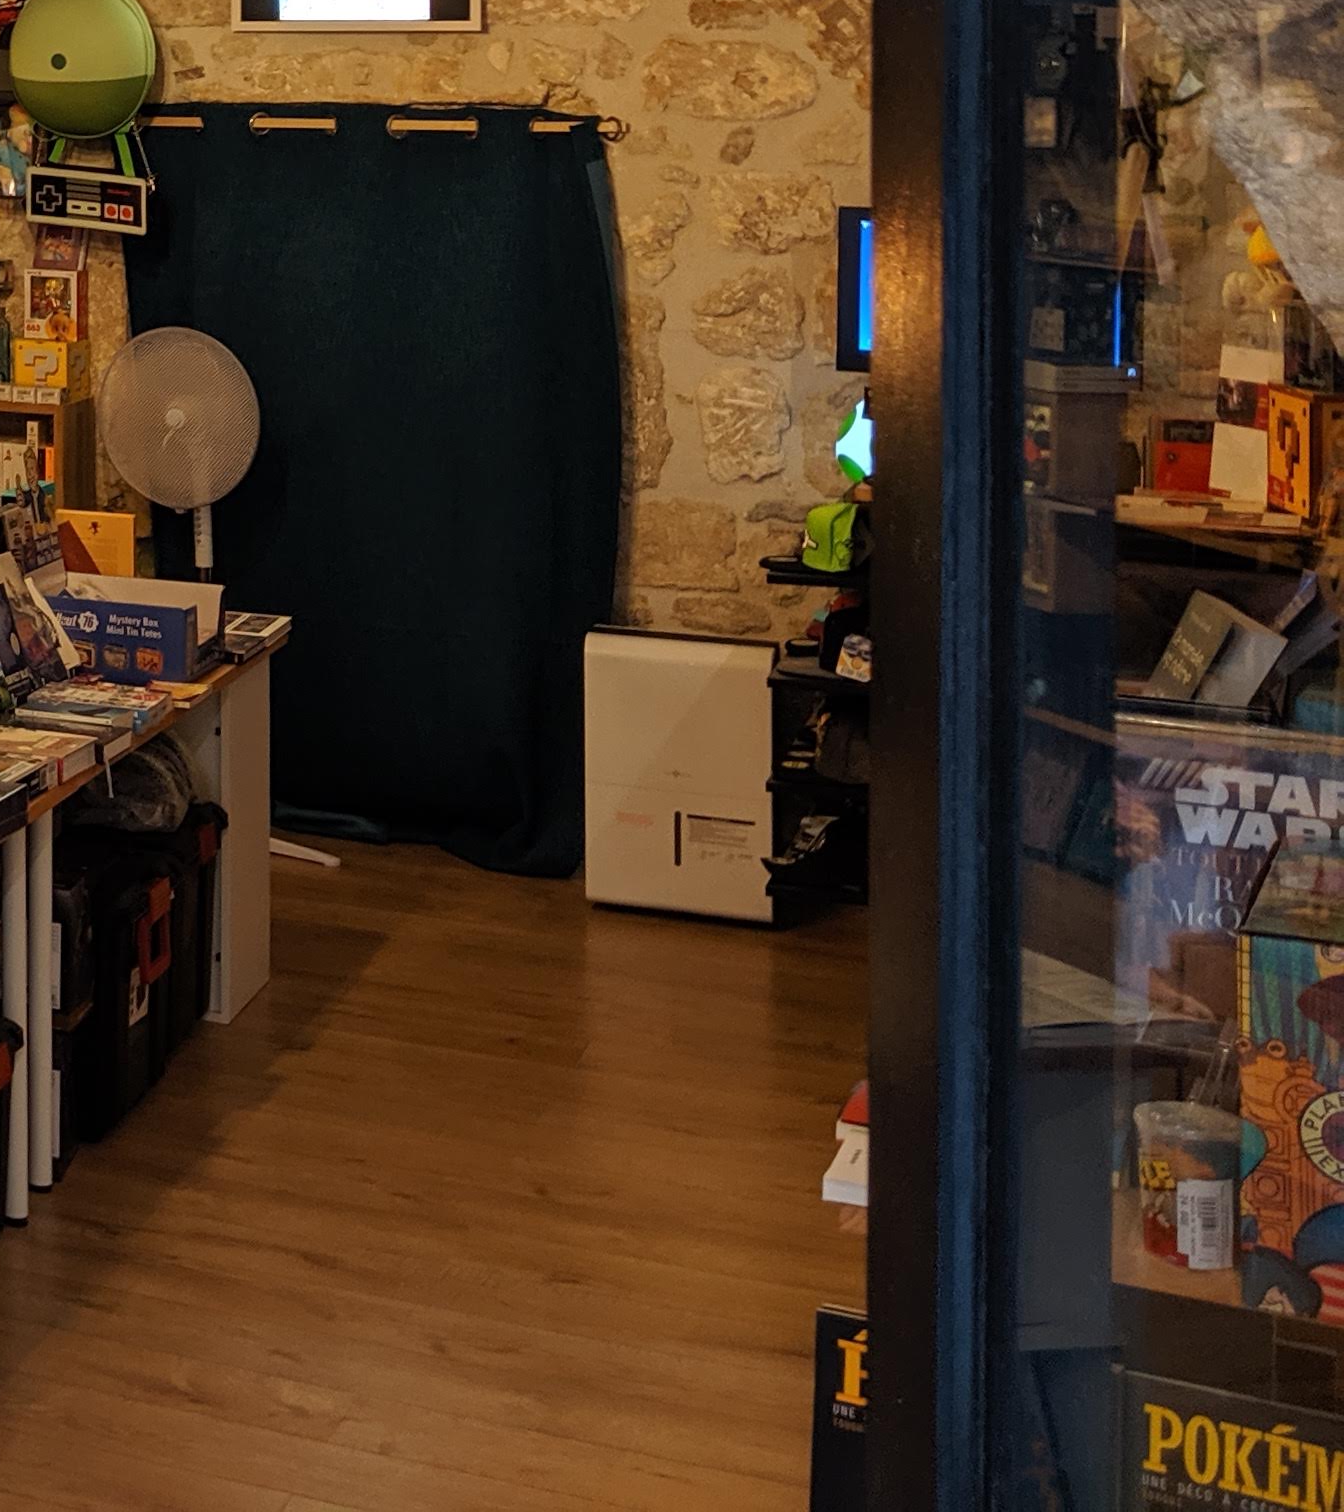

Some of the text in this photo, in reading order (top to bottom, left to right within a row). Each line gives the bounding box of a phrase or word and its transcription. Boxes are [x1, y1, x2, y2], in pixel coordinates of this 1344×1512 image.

[109, 614, 159, 628] Mystery Box
[106, 625, 163, 640] Mini Tin Totes
[1175, 768, 1344, 819] STAR
